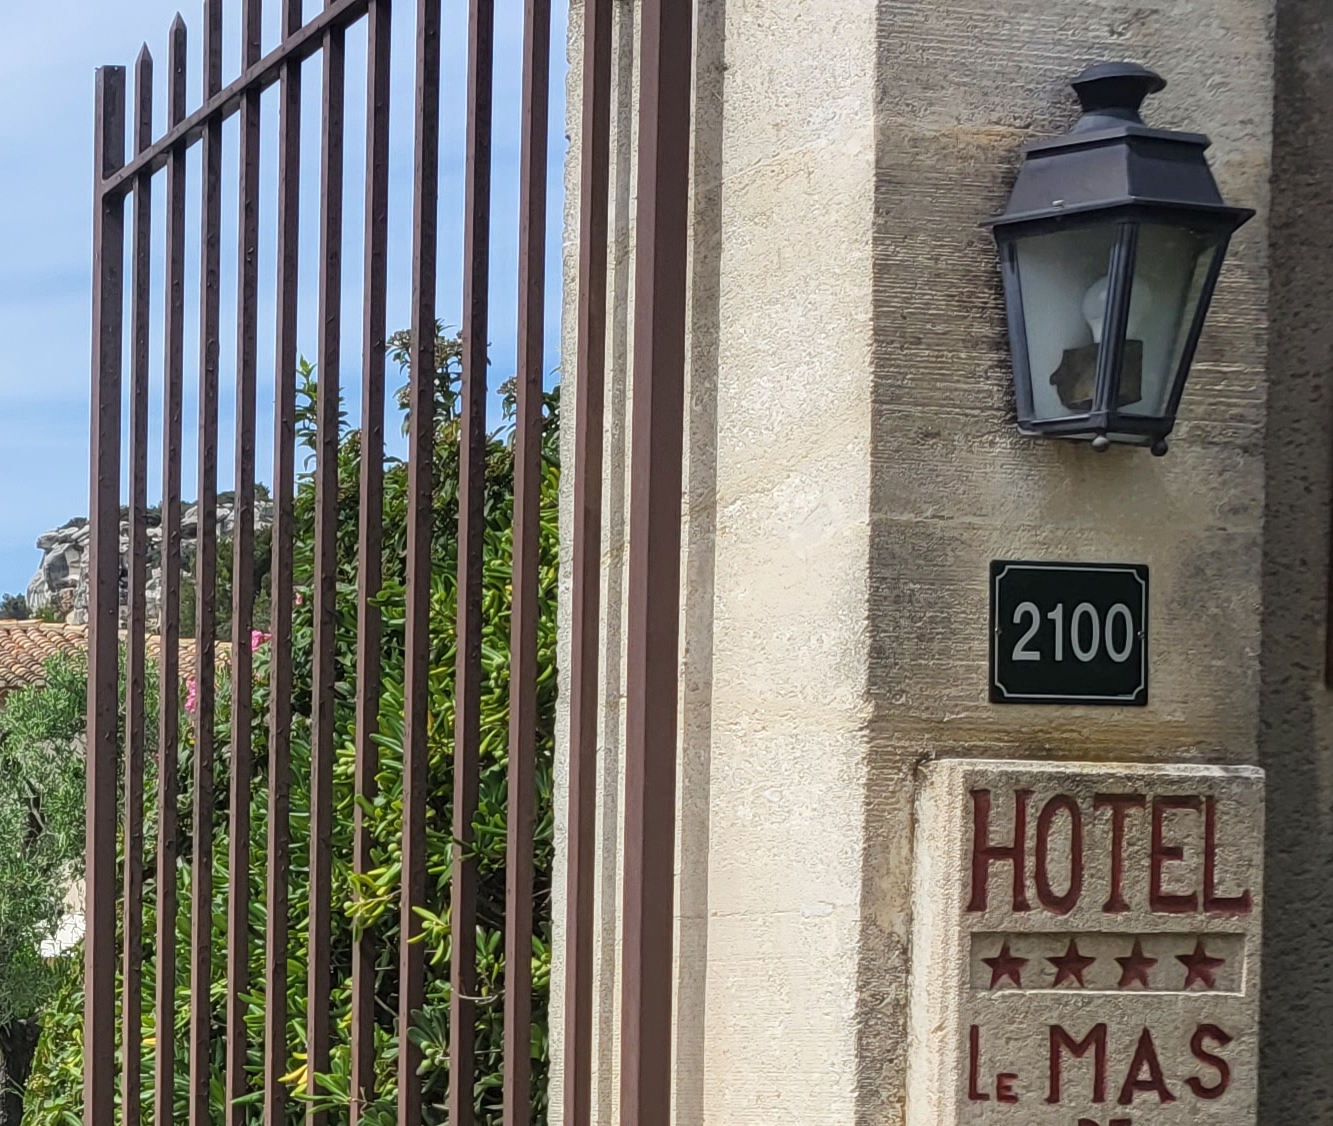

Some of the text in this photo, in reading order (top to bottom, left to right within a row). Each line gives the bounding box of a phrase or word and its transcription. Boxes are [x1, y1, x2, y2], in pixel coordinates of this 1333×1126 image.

[1011, 602, 1135, 663] 2100
[967, 788, 1252, 914] HOTEL
[1046, 1022, 1233, 1106] MAS
